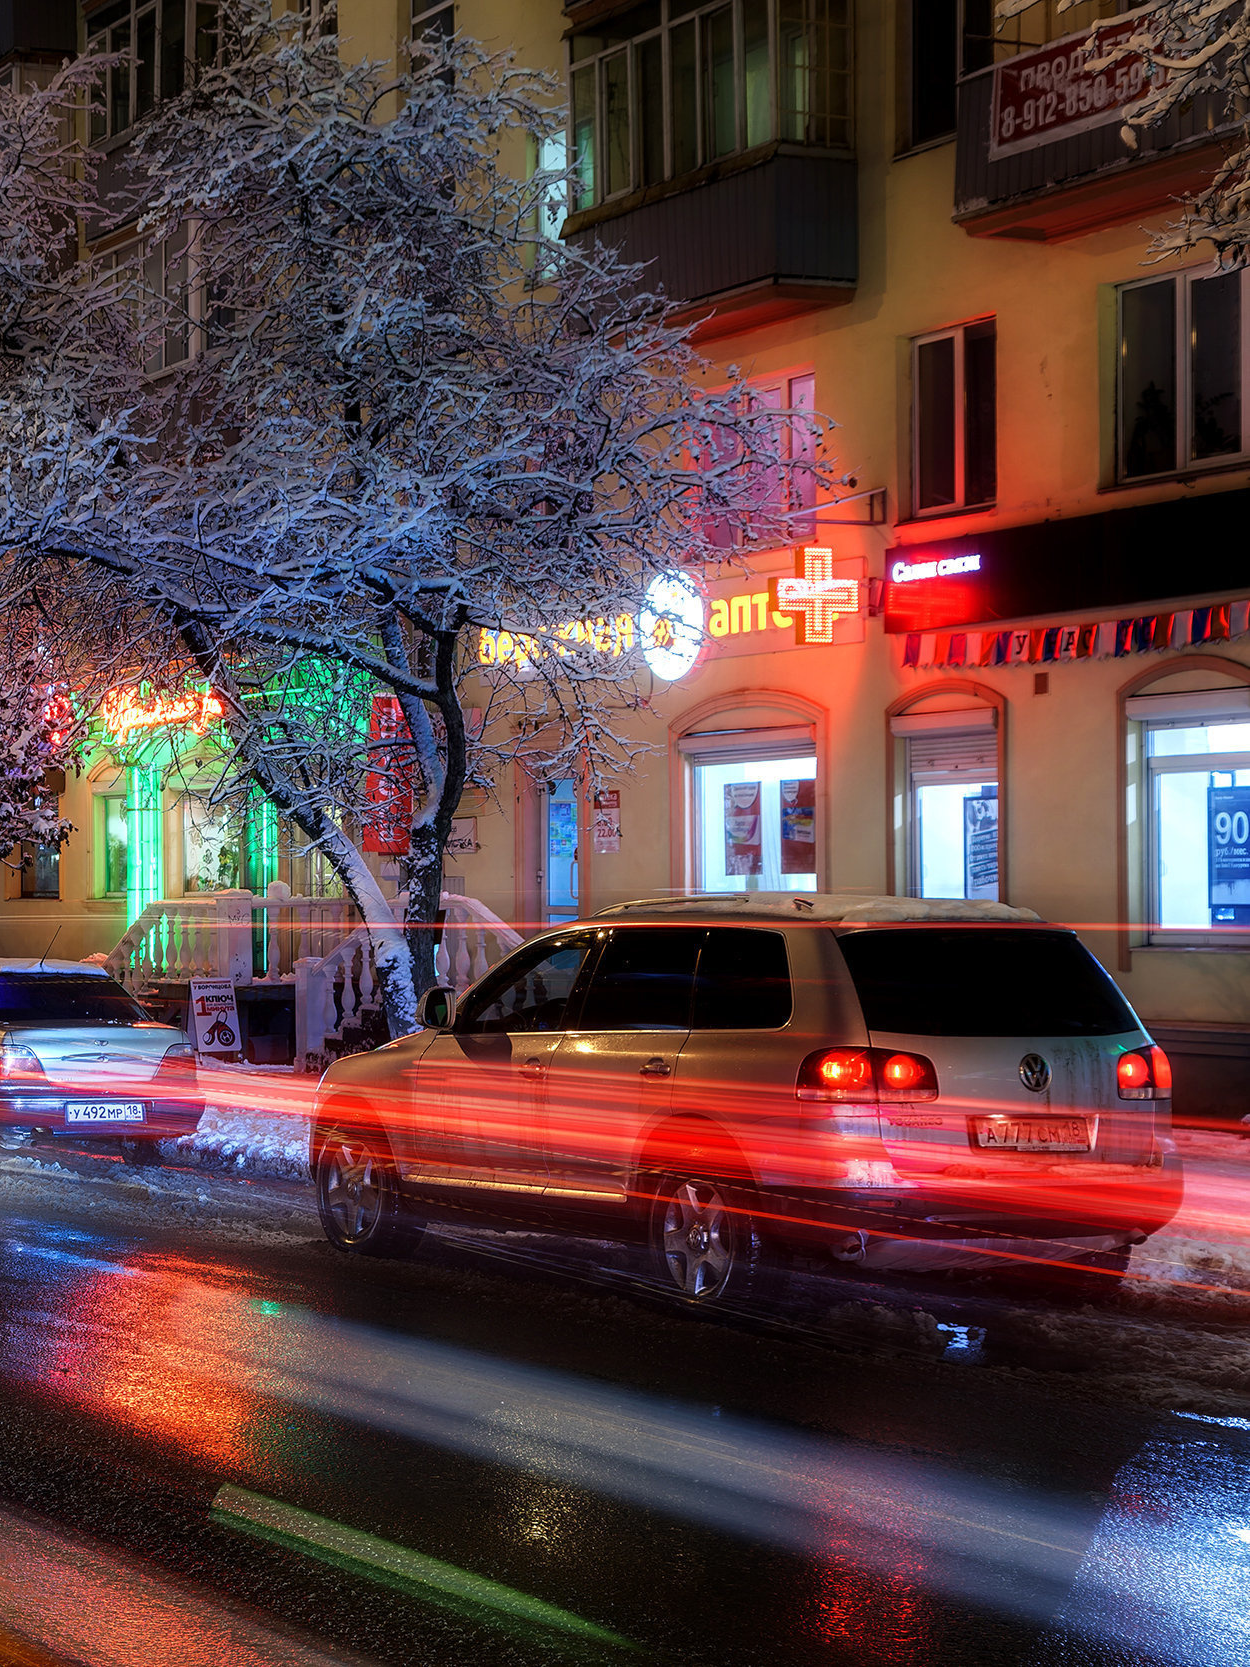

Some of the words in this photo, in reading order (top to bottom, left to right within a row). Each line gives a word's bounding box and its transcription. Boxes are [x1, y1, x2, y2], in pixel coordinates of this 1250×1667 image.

[1020, 20, 1162, 92] ПРОДАЕТ
[1215, 811, 1249, 845] 90
[196, 995, 212, 1016] 1
[126, 1105, 138, 1115] 18
